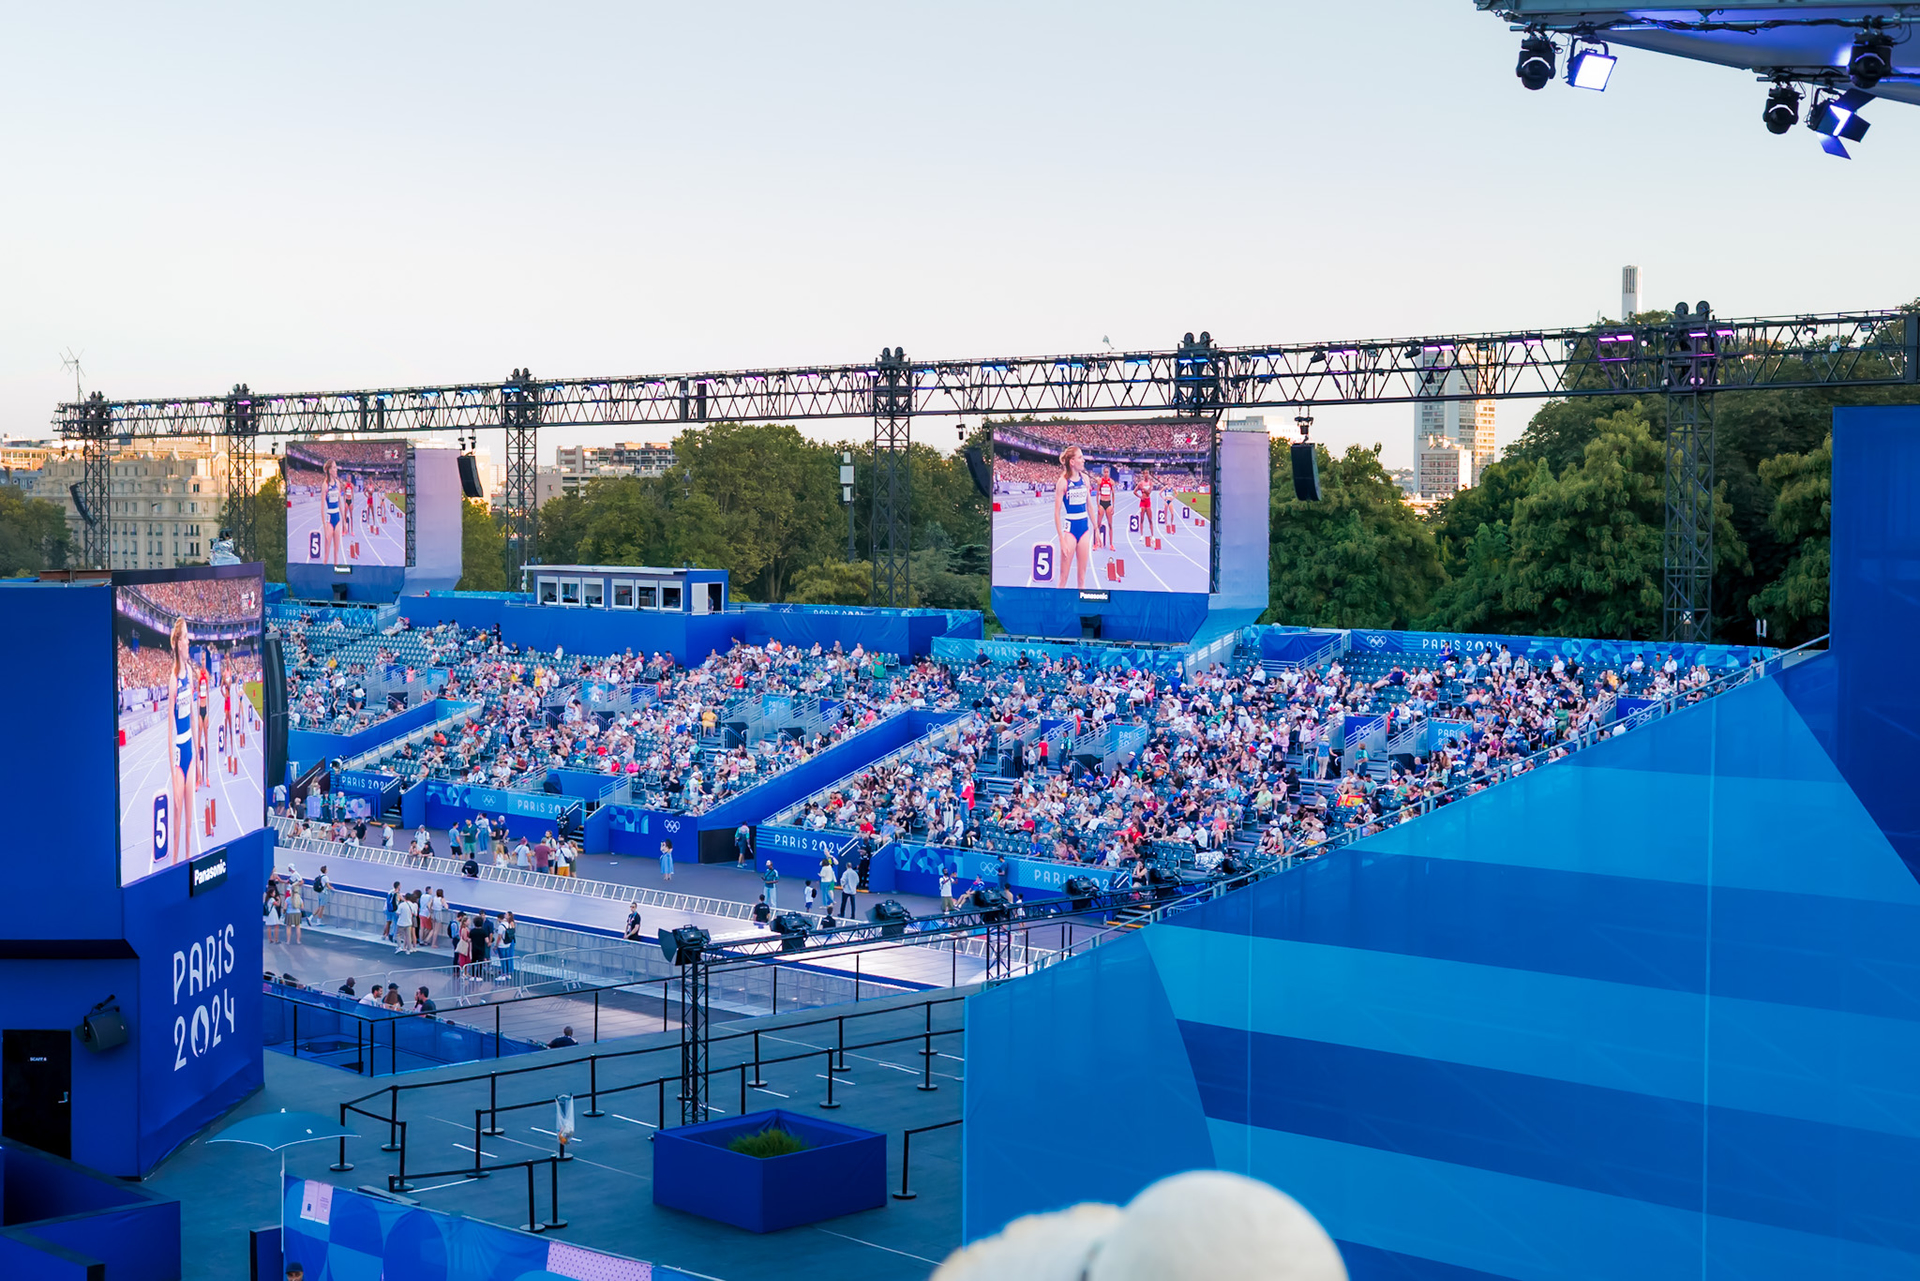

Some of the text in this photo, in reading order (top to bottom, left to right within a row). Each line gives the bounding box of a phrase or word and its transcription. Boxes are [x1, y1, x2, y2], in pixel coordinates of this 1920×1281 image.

[1190, 432, 1198, 445] 2
[1131, 518, 1138, 530] 3
[311, 537, 319, 555] 5
[1036, 552, 1050, 576] 5
[1079, 591, 1108, 600] Panasonic
[341, 775, 366, 791] PARIS
[517, 799, 546, 813] PARIS
[155, 808, 167, 849] 5
[774, 834, 808, 850] PARIS
[194, 858, 227, 886] Panasonic
[173, 923, 235, 1005] PARIS
[173, 988, 235, 1072] 2024
